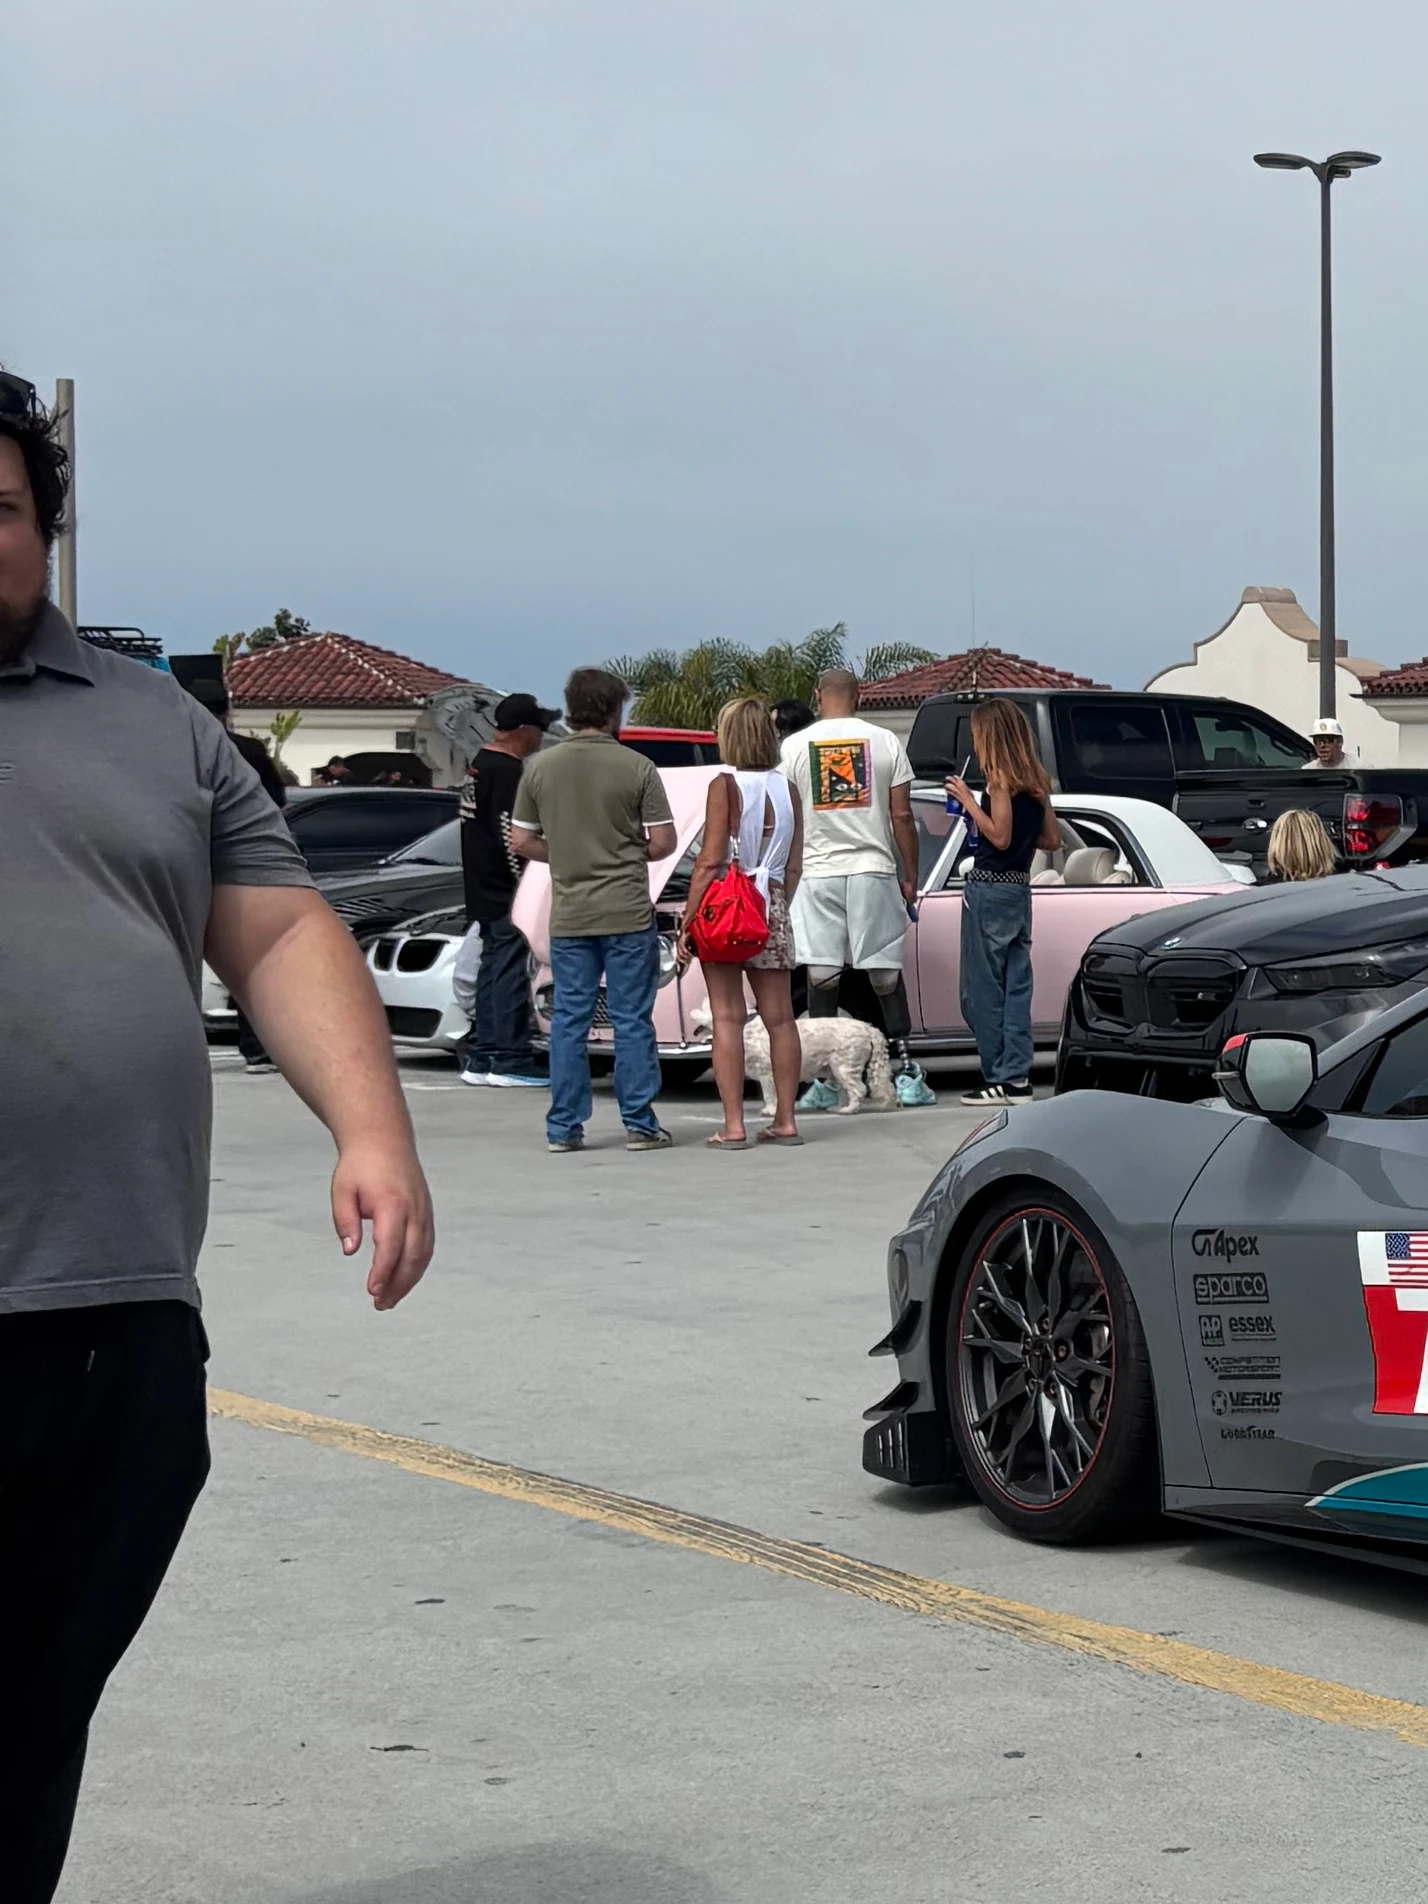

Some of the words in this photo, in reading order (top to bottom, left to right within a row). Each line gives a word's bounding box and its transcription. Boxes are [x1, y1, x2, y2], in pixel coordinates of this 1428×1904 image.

[1195, 1275, 1266, 1304] sparco
[1229, 1316, 1276, 1334] essex
[1229, 1391, 1282, 1406] VERUS
